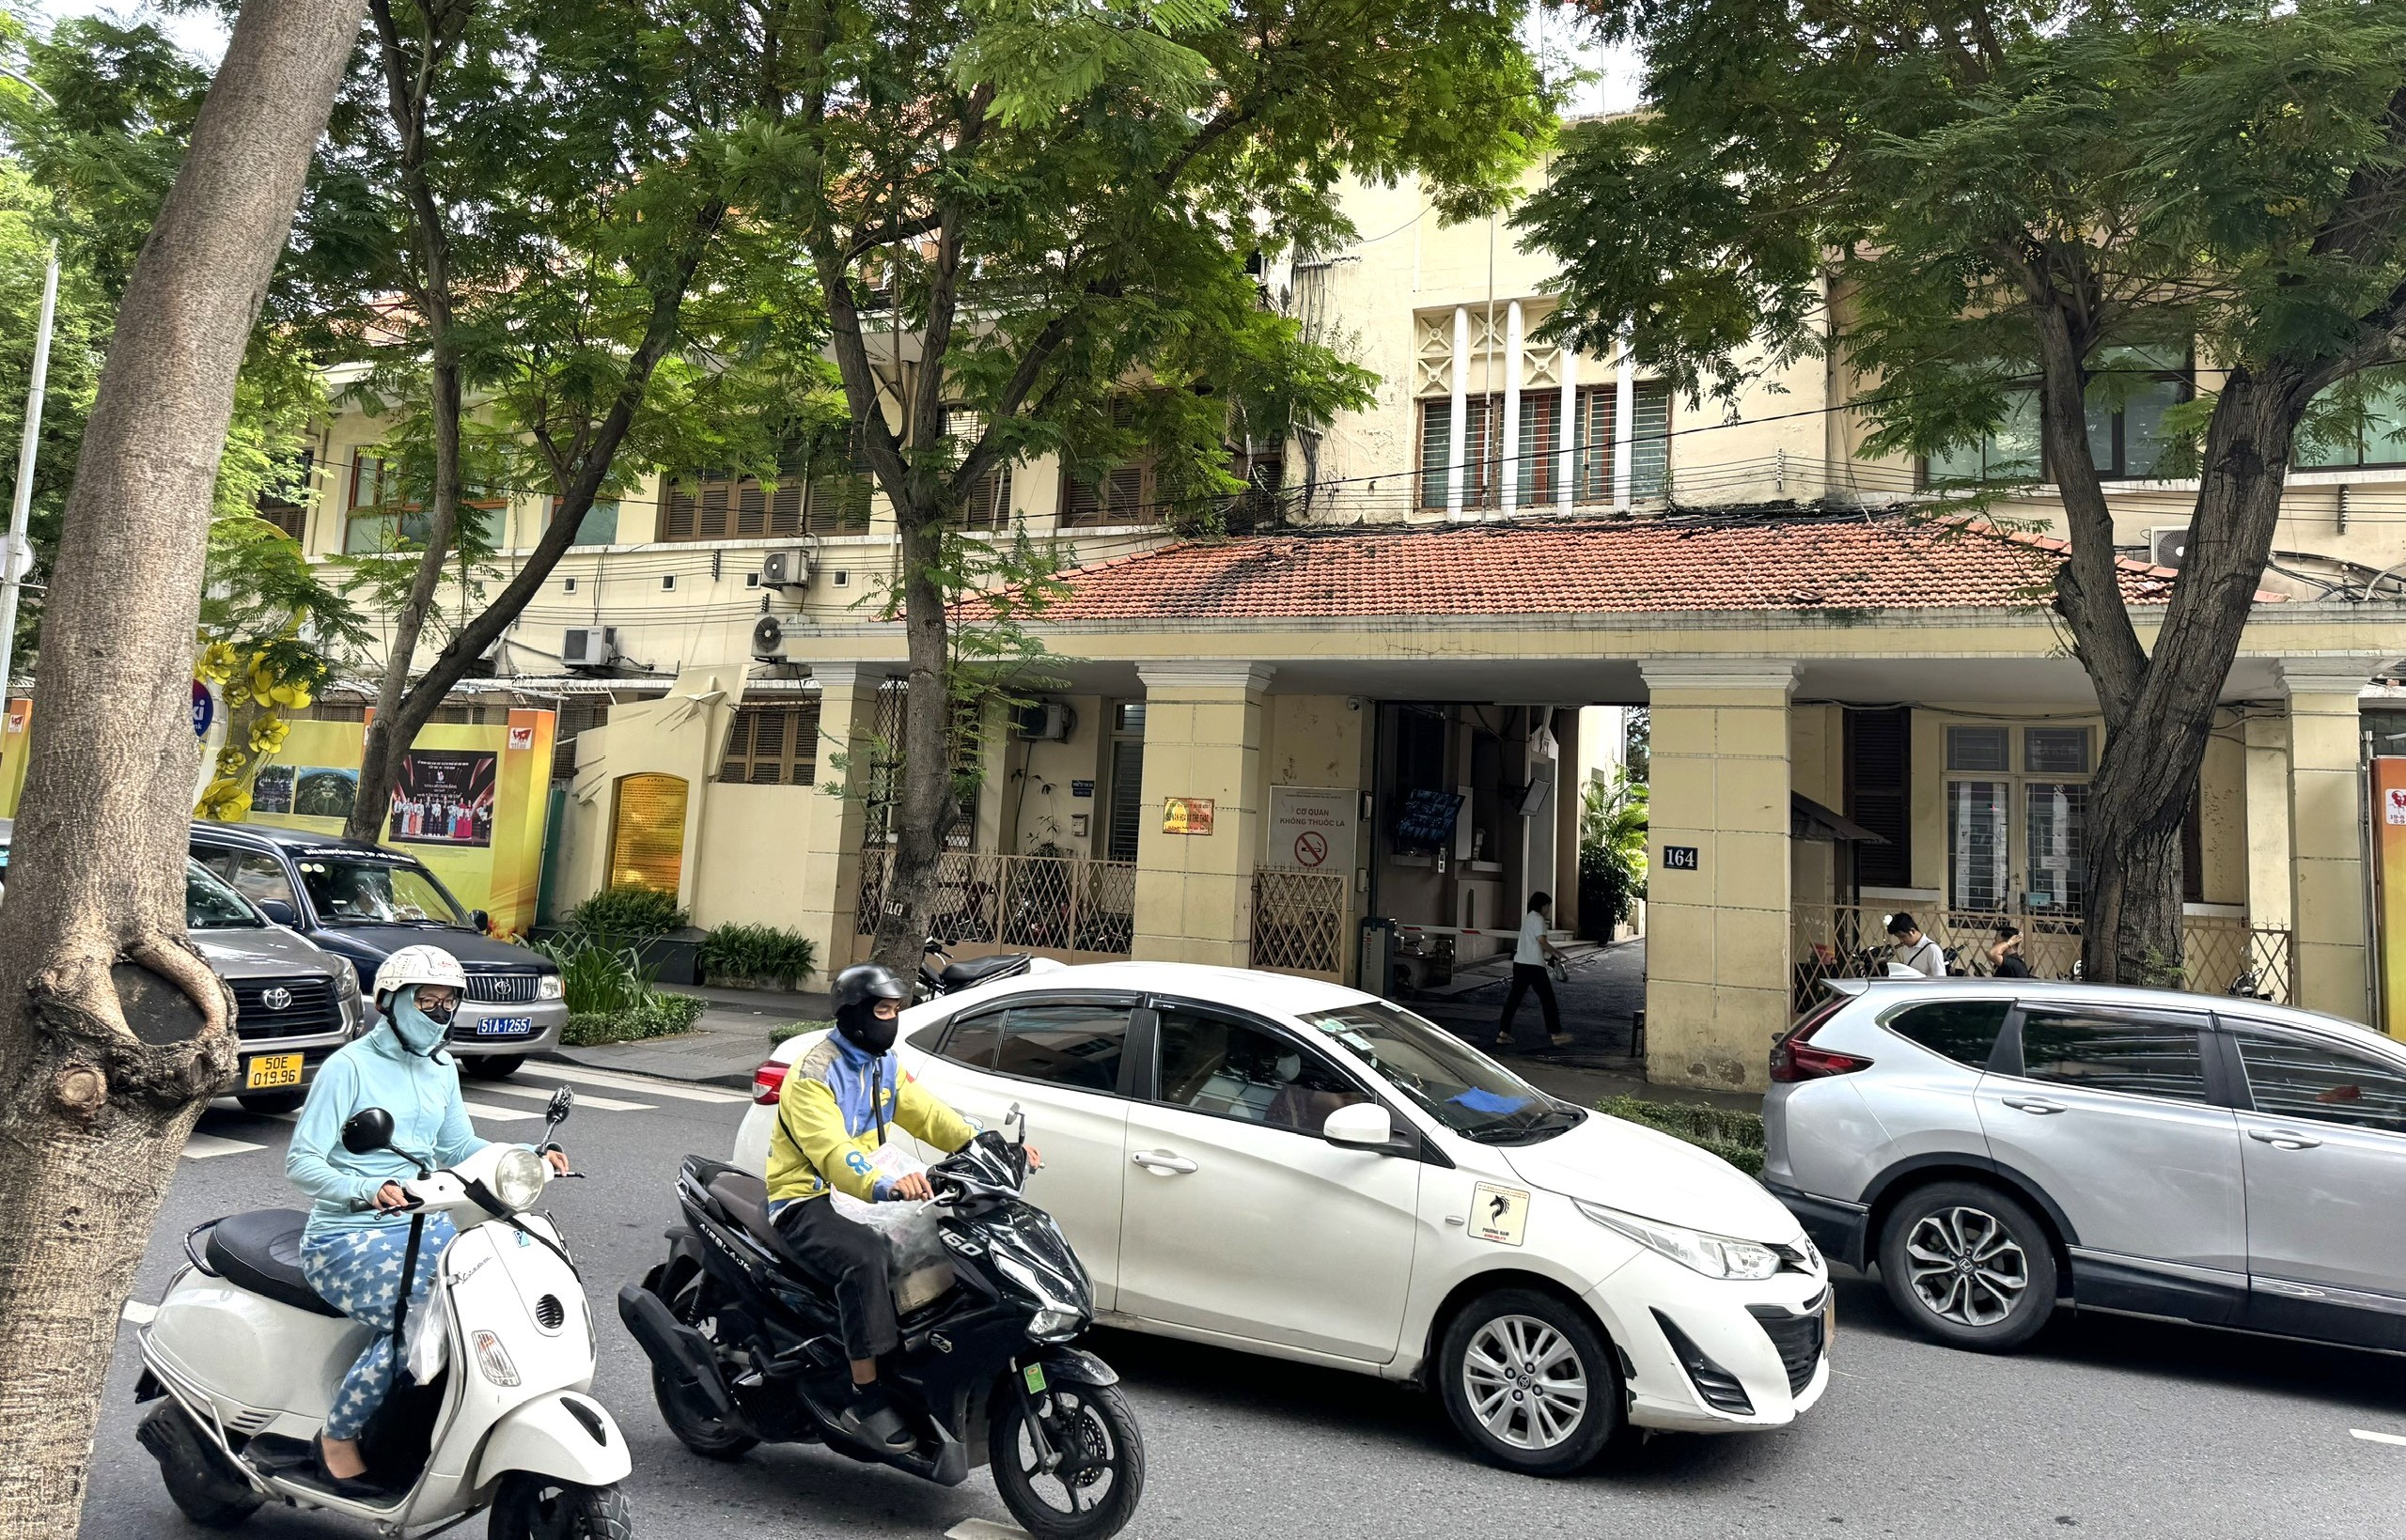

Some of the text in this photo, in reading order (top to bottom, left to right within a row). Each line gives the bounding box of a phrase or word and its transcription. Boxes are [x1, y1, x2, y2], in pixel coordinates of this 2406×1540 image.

[1666, 848, 1695, 867] 164
[265, 1056, 289, 1070] 50E
[253, 1069, 296, 1085] 019.96
